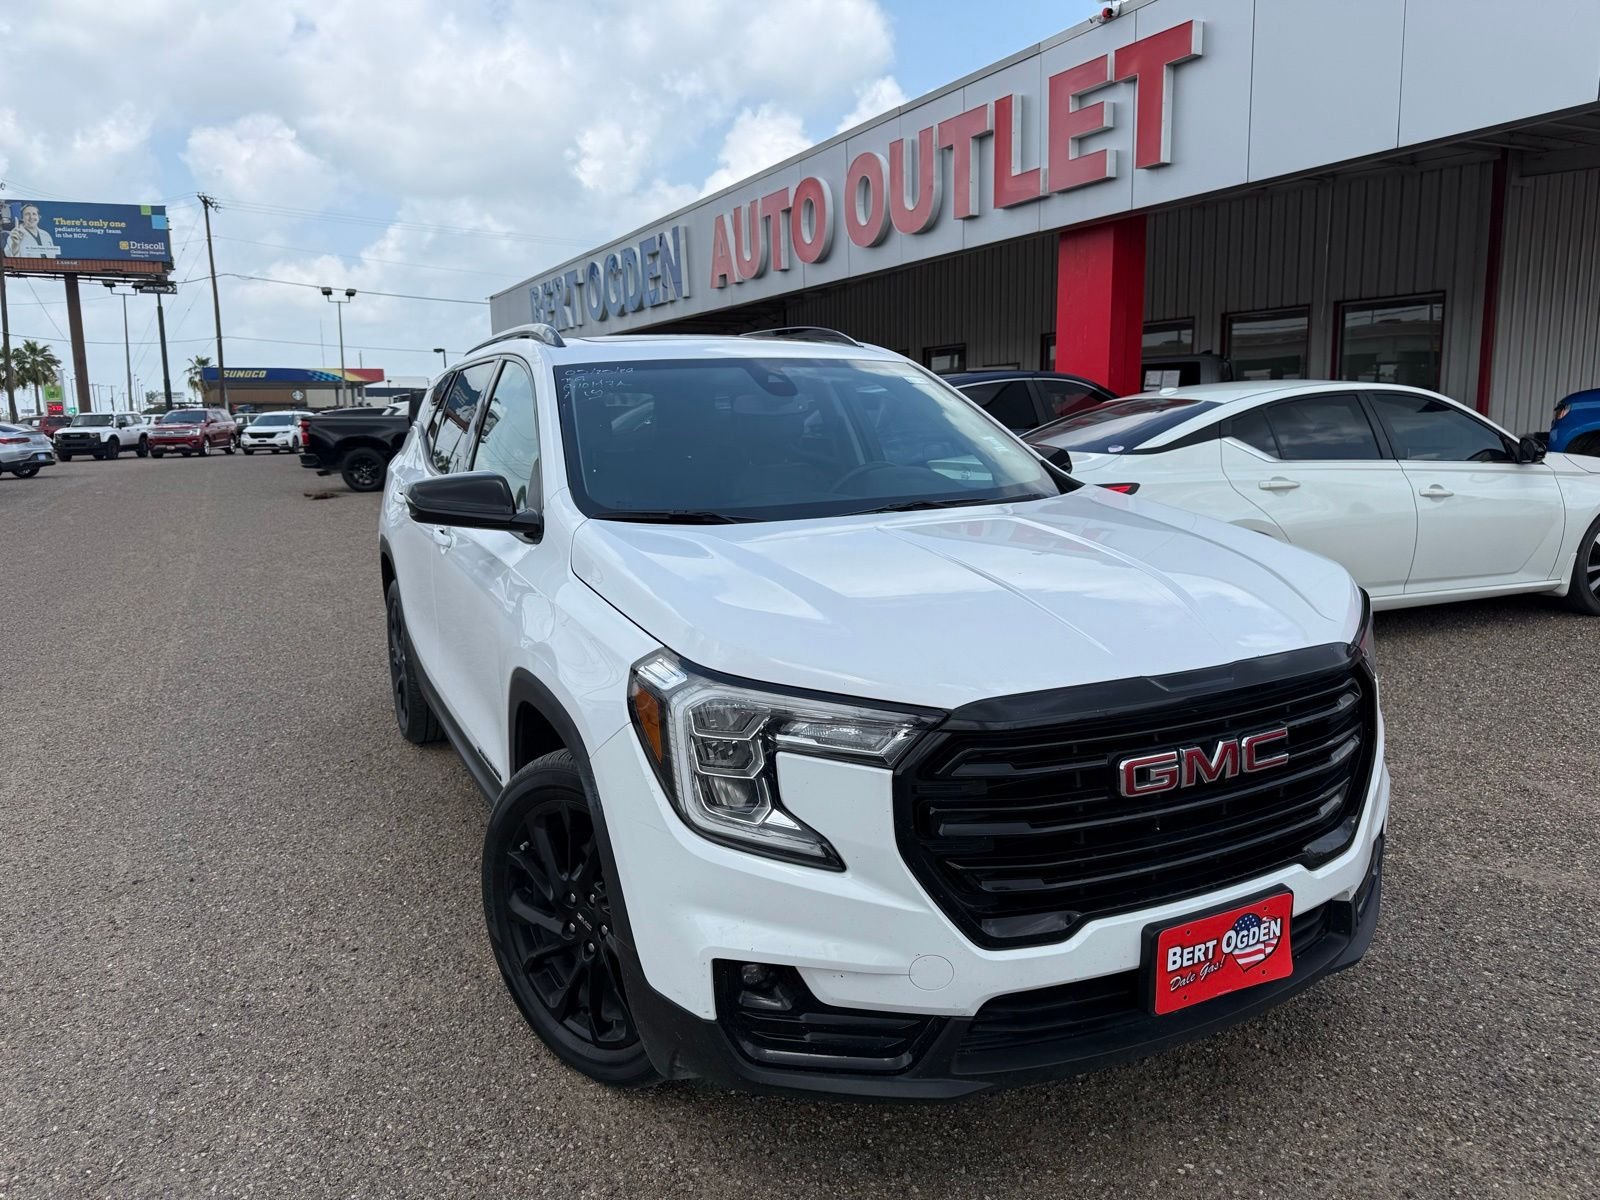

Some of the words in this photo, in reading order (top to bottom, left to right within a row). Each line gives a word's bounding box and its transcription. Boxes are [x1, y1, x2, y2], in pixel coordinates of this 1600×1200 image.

[529, 268, 583, 331] BERT
[585, 225, 690, 321] OGDEN
[710, 177, 834, 288] AUTO
[845, 20, 1203, 248] OUTLET
[53, 217, 87, 226] There's
[88, 219, 108, 228] only
[130, 241, 165, 250] Driscoll
[224, 370, 267, 378] SUNOCO
[1120, 727, 1288, 797] GMC
[1167, 939, 1218, 972] BERT
[1221, 917, 1281, 954] OGDEN
[1170, 971, 1196, 991] Dale
[1200, 954, 1225, 981] Gas!
